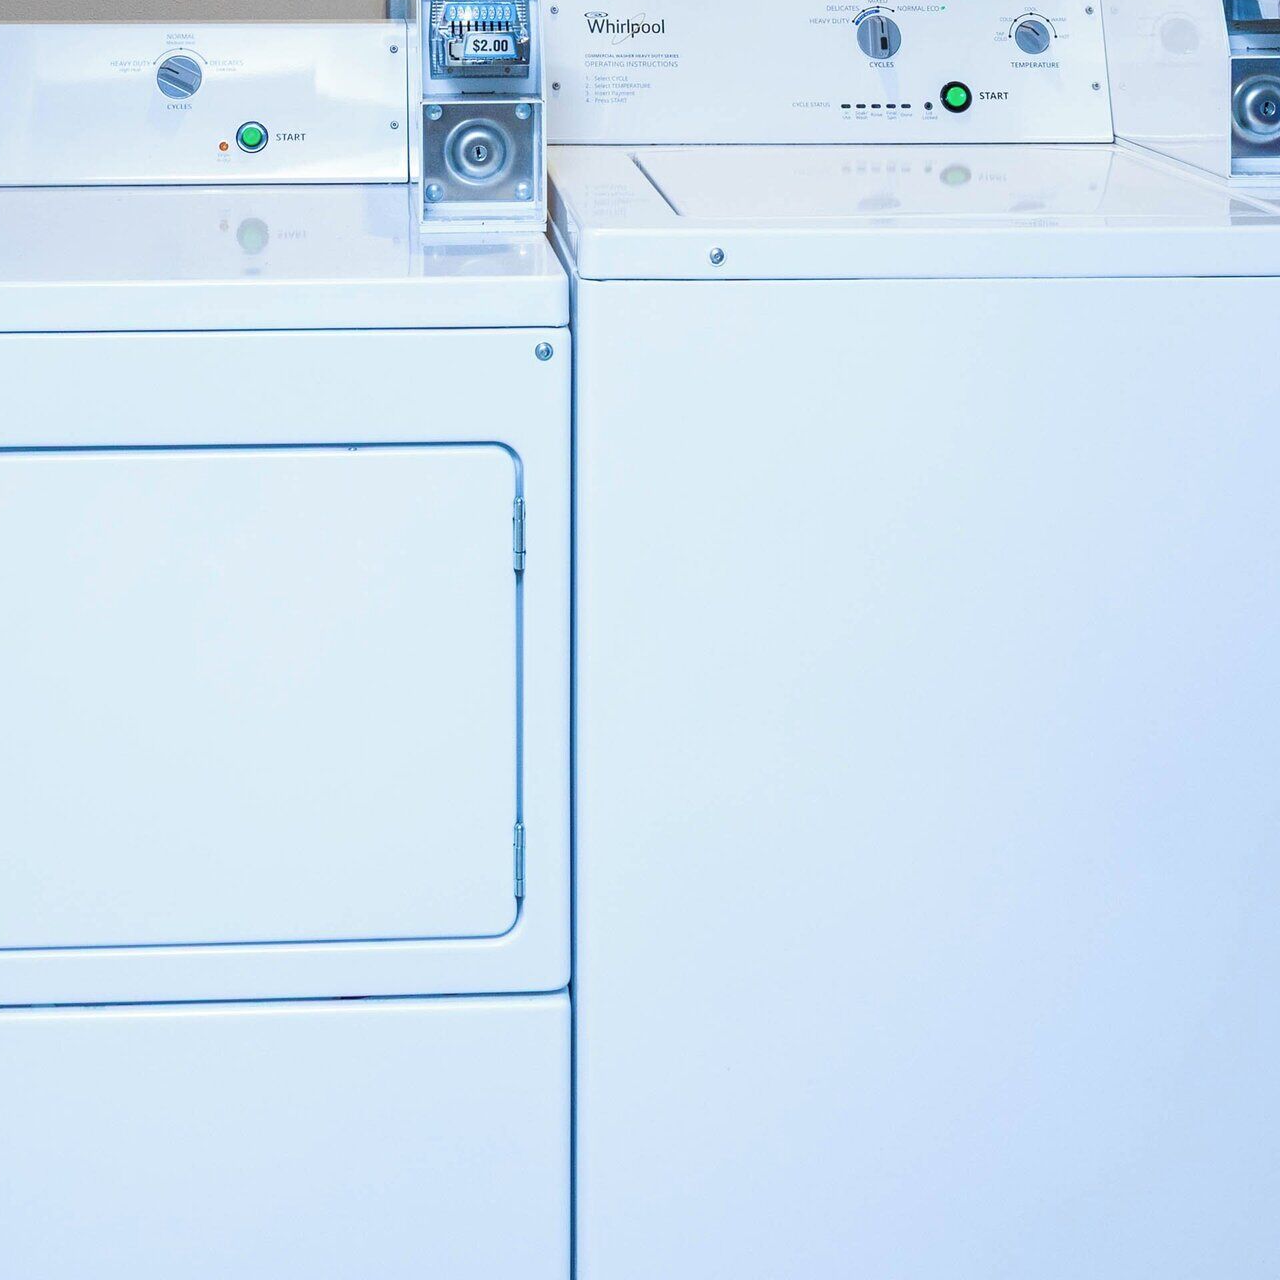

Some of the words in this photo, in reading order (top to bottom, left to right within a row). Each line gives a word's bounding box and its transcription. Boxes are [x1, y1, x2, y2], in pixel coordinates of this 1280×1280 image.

[587, 19, 665, 38] Whirlpool
[472, 39, 509, 53] $2.00
[979, 91, 1009, 100] START
[275, 133, 307, 141] START
